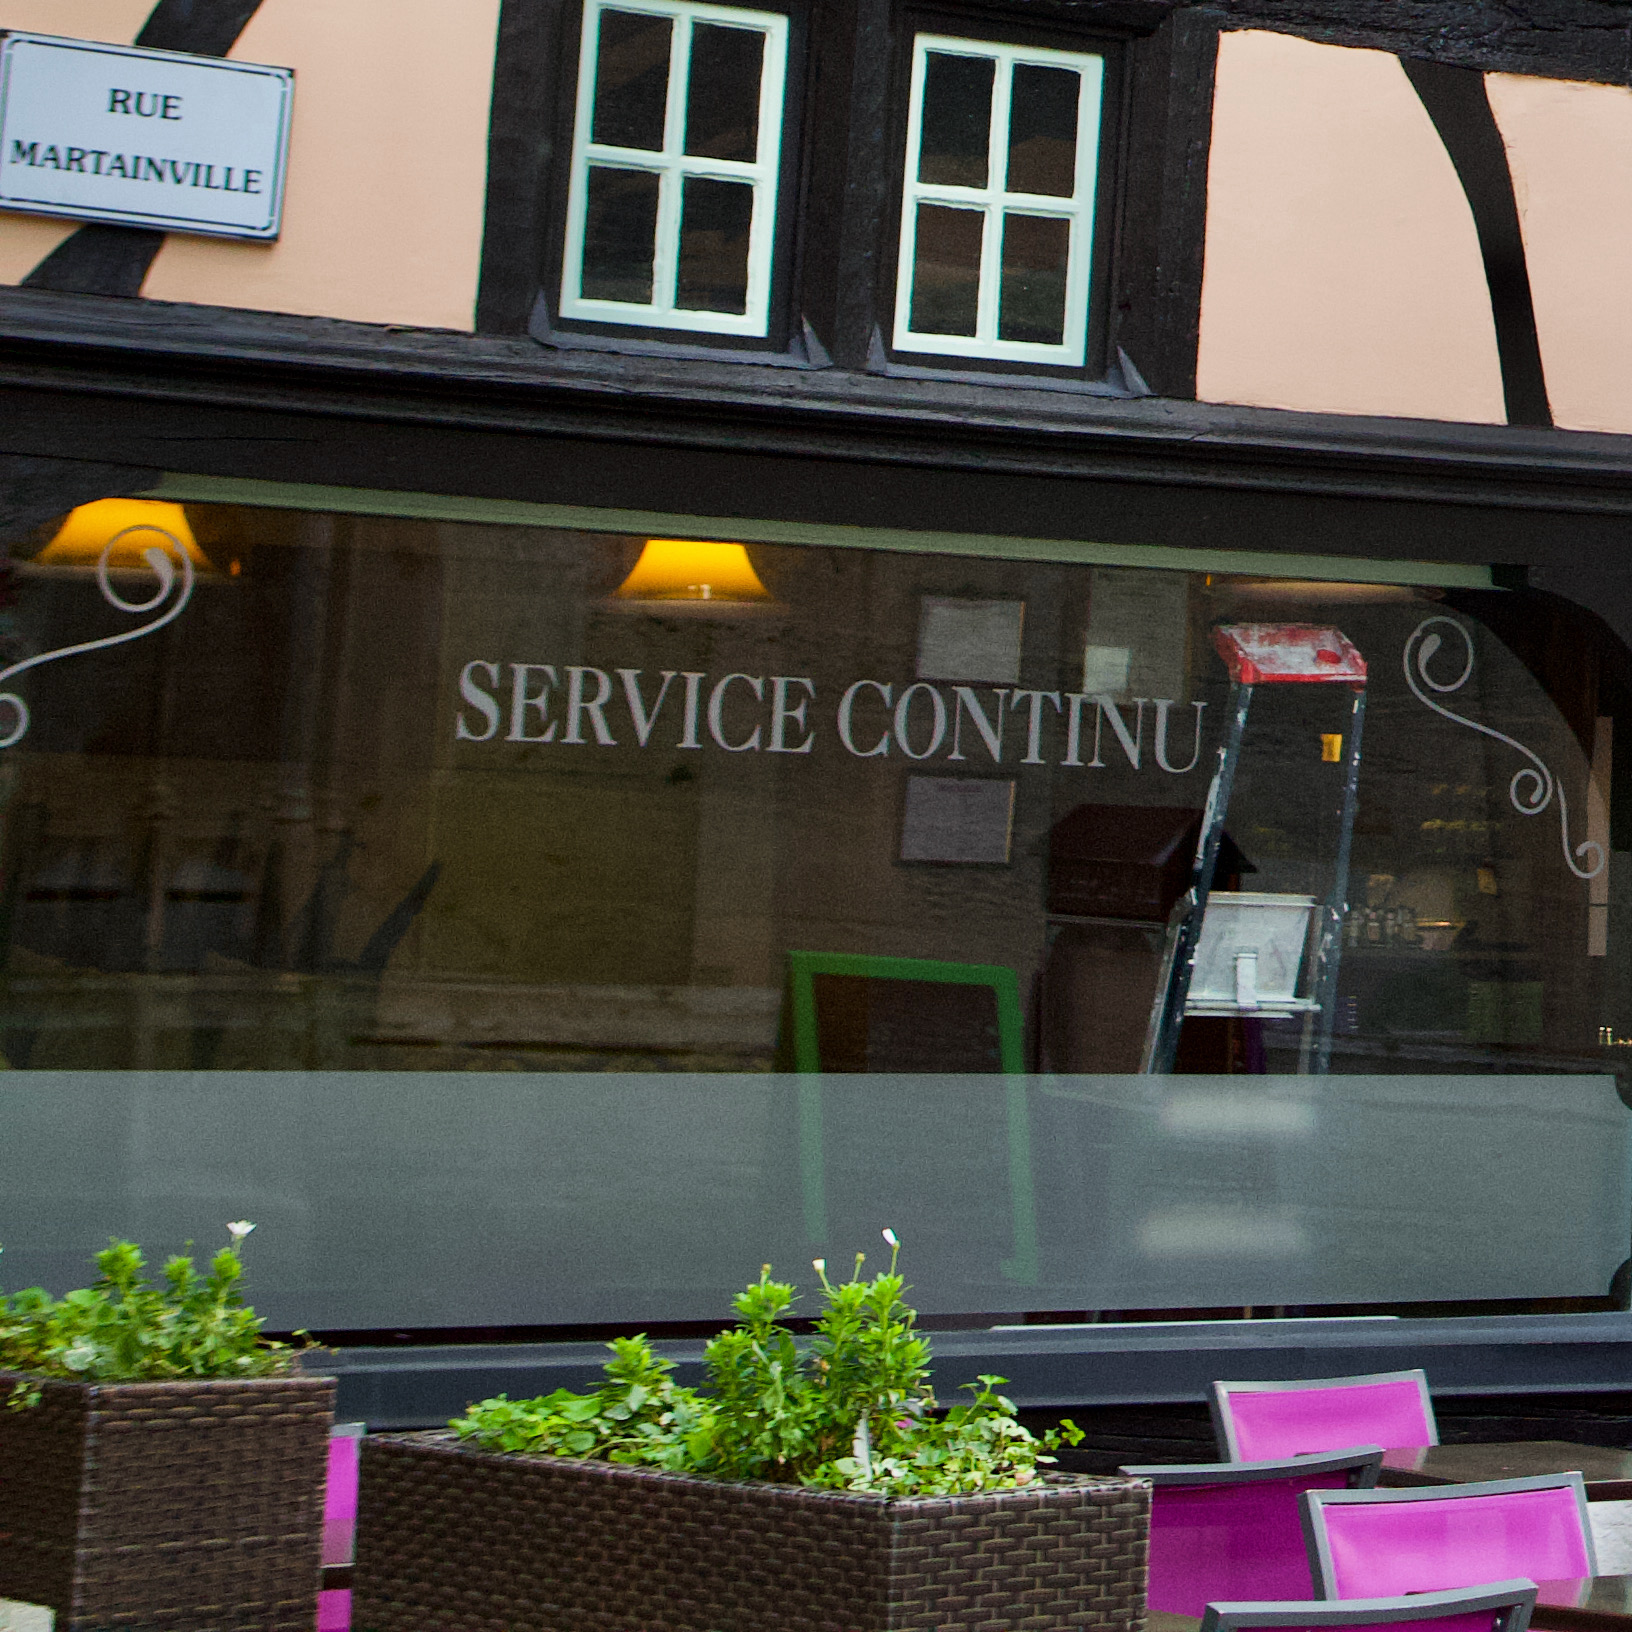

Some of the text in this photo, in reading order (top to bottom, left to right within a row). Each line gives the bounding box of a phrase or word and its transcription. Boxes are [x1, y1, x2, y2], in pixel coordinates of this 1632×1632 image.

[107, 88, 183, 120] RUE
[9, 139, 264, 195] MARTAINVILLE
[456, 659, 1209, 774] SERVICE CONTINU
